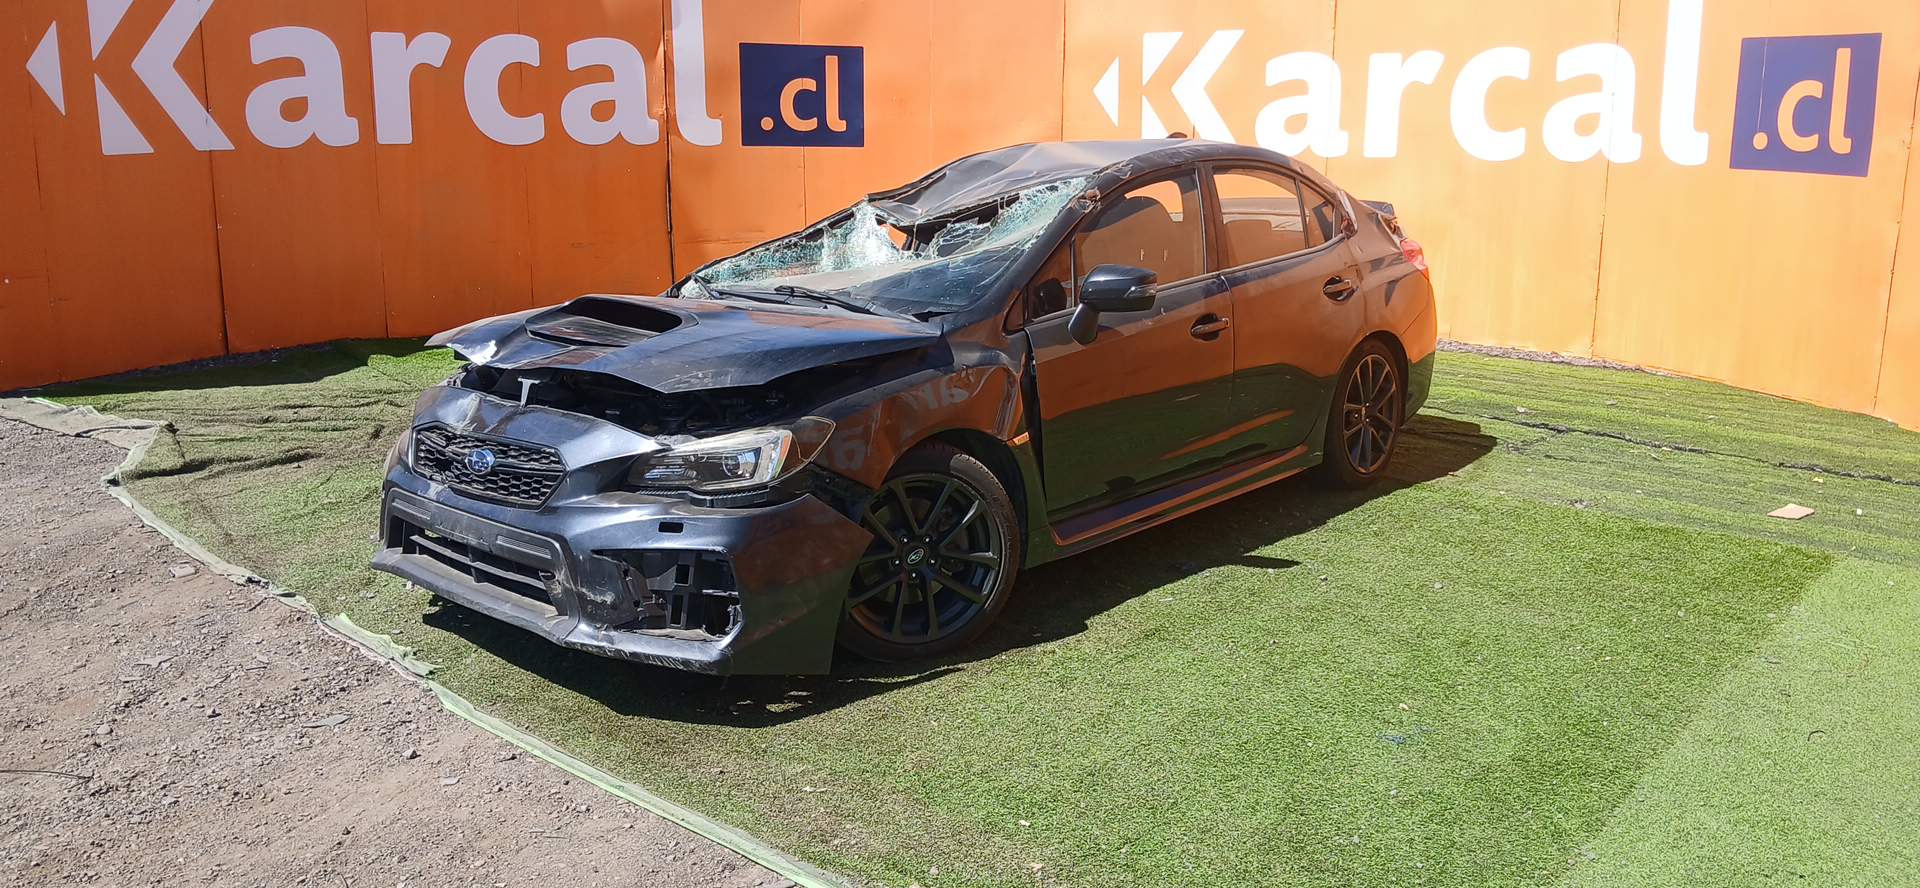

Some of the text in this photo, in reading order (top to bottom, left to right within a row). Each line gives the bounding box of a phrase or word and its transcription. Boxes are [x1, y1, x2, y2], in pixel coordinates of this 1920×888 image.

[86, 0, 848, 155] Karcal .cl
[1141, 0, 1853, 166] Karcal .cl
